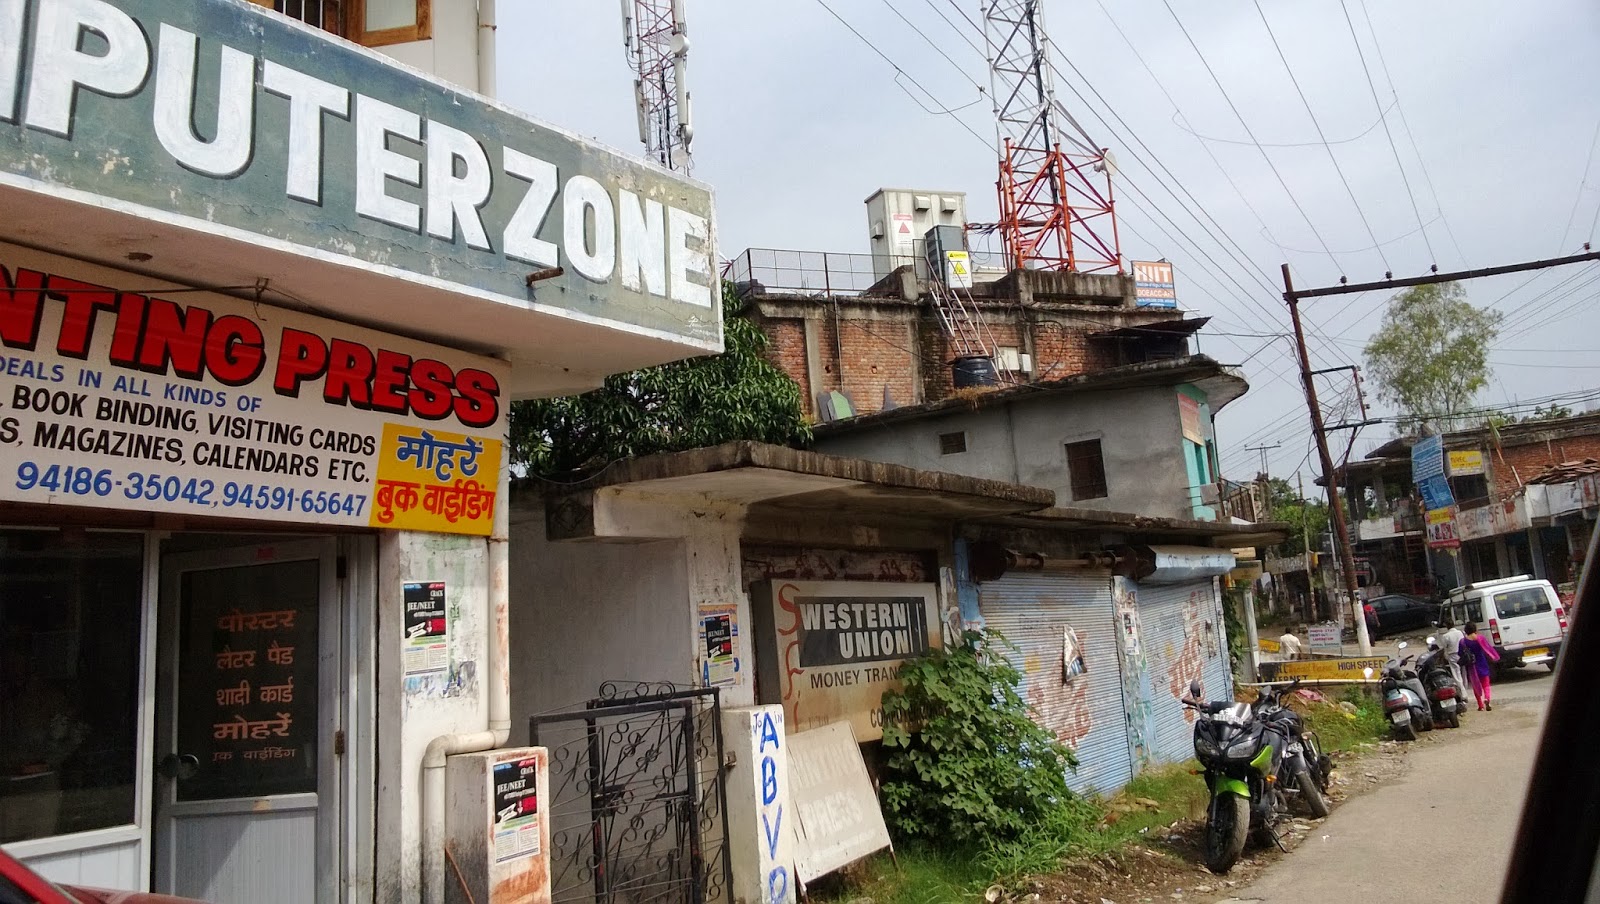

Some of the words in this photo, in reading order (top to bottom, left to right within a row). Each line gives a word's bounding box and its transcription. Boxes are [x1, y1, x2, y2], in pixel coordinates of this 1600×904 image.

[1134, 264, 1171, 284] NIIT
[78, 368, 102, 389] IN
[113, 375, 151, 397] ALL
[164, 383, 226, 407] KINDS
[237, 395, 262, 412] OF
[274, 327, 500, 428] PRESS
[12, 384, 88, 418] BOOK
[96, 397, 200, 435] BINDING,
[208, 413, 304, 447] VISITING
[309, 428, 376, 456] CARDS
[33, 421, 186, 466] MAGAZINES,
[193, 442, 318, 478] CALENDARS
[328, 458, 370, 483] ETC.
[396, 430, 484, 481] मोहरें
[377, 479, 422, 524] बुक
[217, 608, 297, 632] पोस्टर
[407, 601, 435, 612] JEE/NEET
[800, 602, 907, 631] WESTERN
[838, 629, 910, 659] UNION
[811, 669, 860, 689] MONEY
[1338, 661, 1357, 671] HIGH
[216, 680, 250, 706] शादी
[260, 676, 294, 703] कार्ड
[497, 779, 526, 795] JEE/NEET
